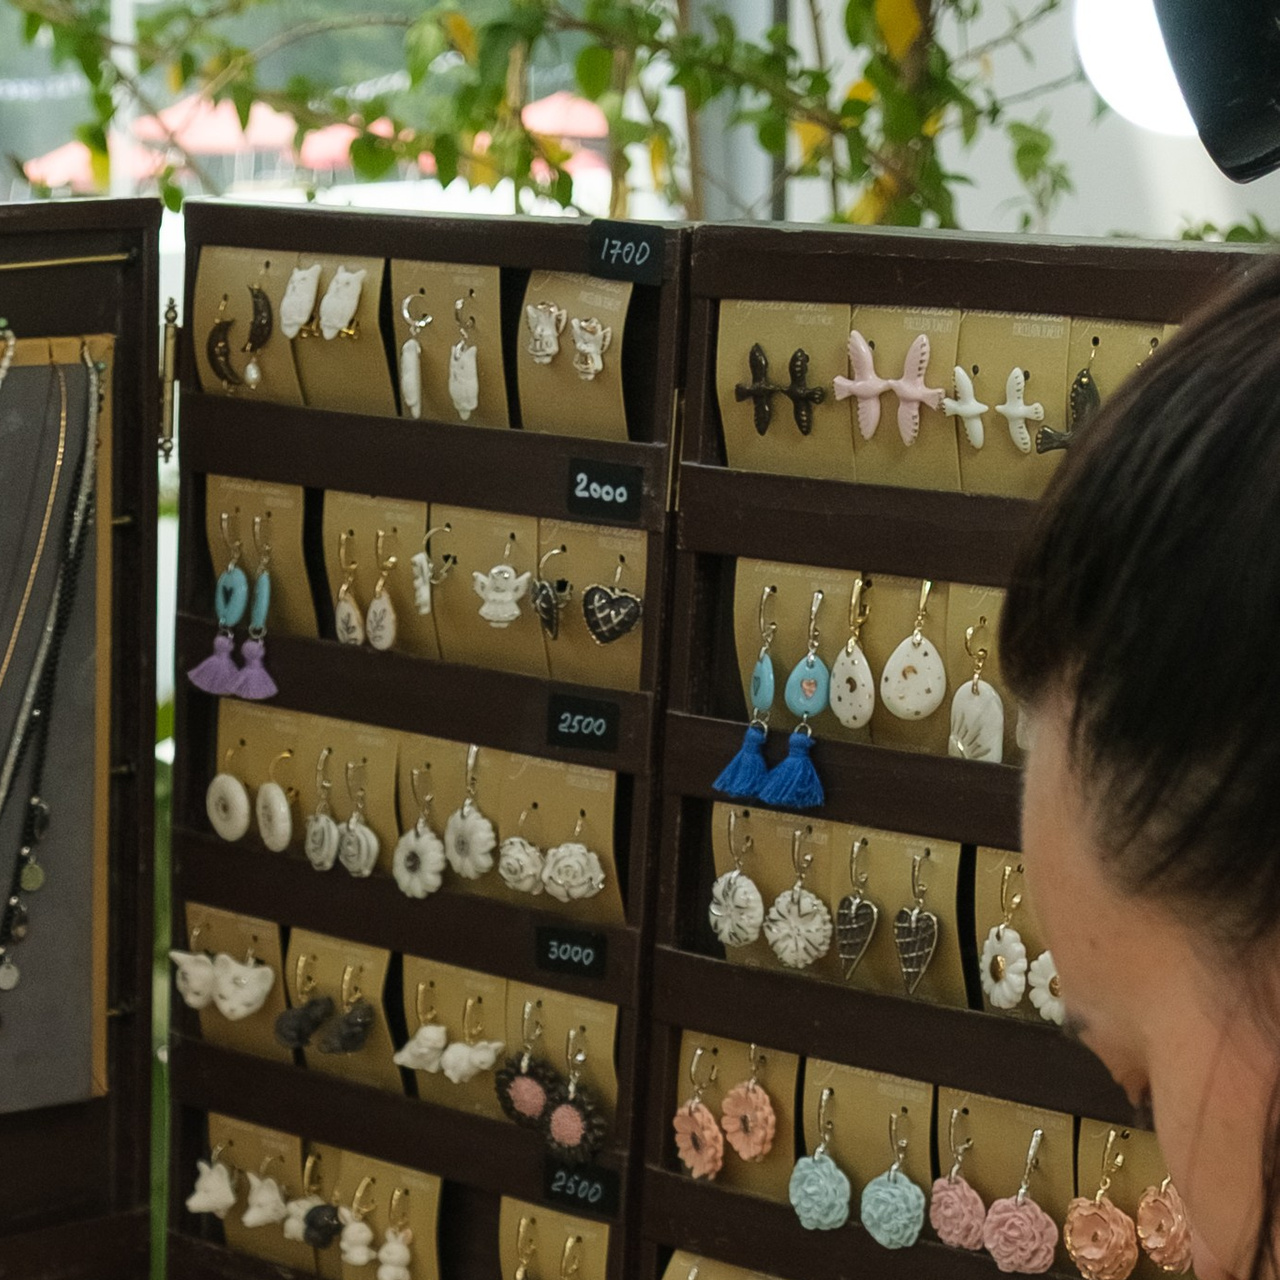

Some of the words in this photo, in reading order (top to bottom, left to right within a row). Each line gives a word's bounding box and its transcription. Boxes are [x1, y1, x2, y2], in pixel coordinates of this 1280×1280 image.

[601, 237, 651, 267] 1700
[574, 472, 629, 504] 2000
[558, 711, 607, 737] 2500
[548, 940, 595, 967] 3000
[551, 1170, 603, 1204] 2500
